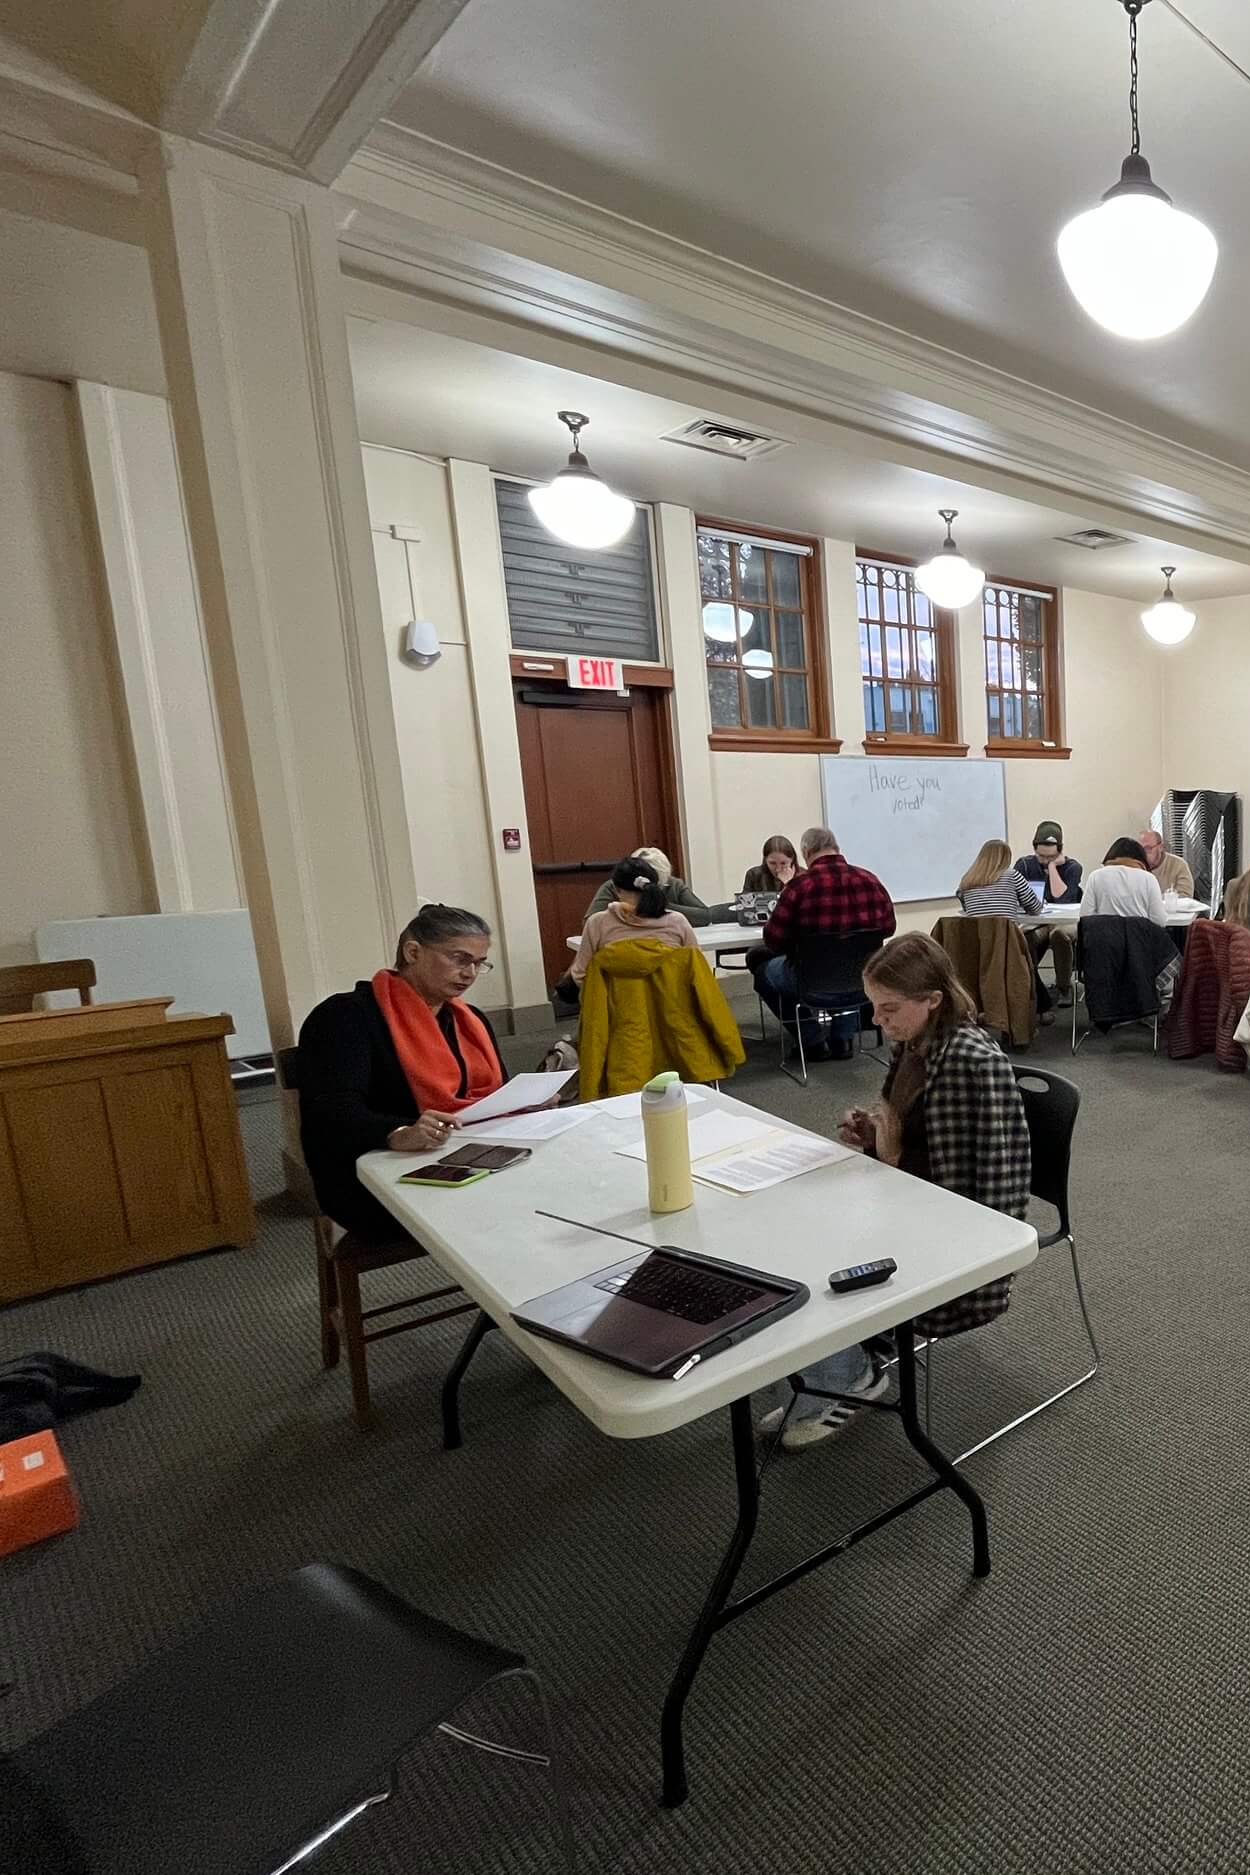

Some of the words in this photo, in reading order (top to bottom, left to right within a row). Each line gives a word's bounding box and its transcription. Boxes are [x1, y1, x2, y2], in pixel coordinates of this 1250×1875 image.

[578, 659, 615, 687] EXIT
[868, 764, 912, 793] Have
[916, 775, 942, 807] you
